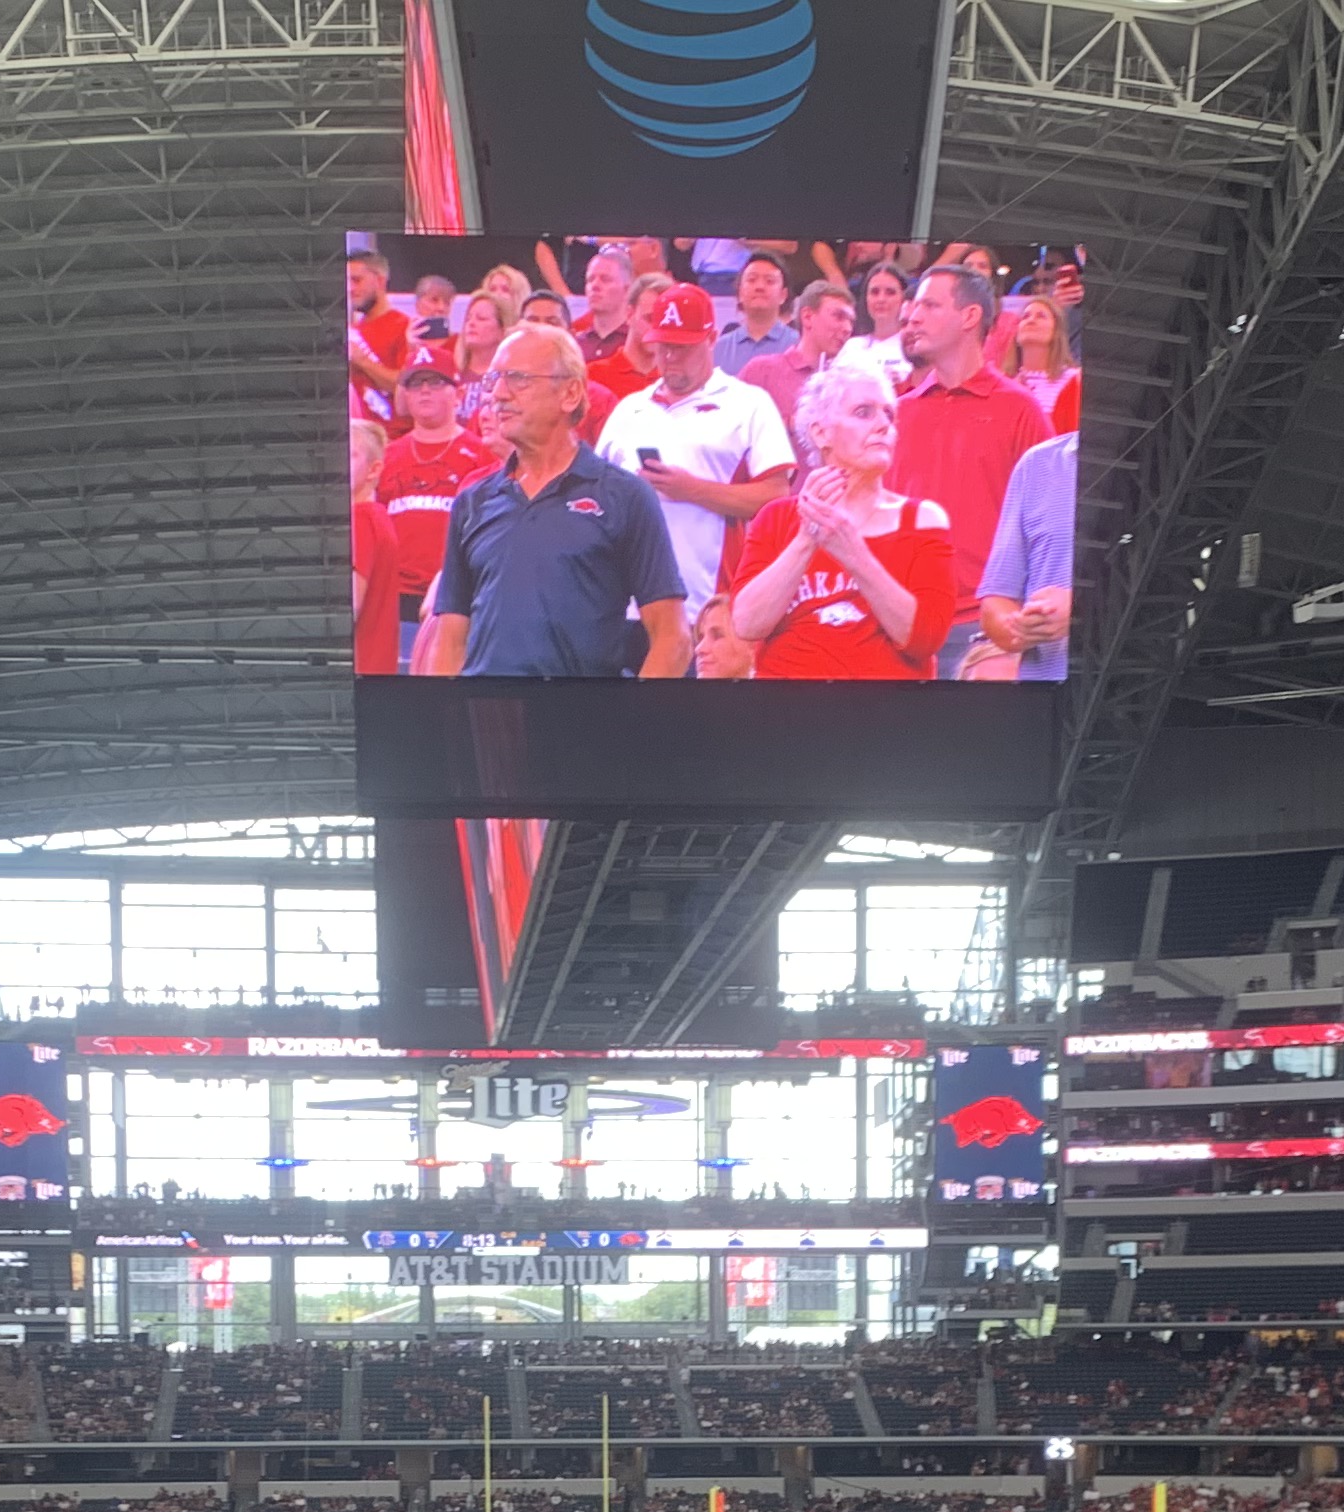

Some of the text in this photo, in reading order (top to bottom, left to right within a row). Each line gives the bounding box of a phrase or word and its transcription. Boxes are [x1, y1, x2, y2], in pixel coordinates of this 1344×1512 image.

[659, 301, 684, 327] A
[413, 346, 434, 365] A
[1065, 1031, 1210, 1054] RAZORBACKS
[32, 1045, 61, 1063] Lite
[941, 1049, 969, 1067] Lite
[1011, 1047, 1041, 1066] Lite
[468, 1075, 571, 1129] Lite
[1064, 1143, 1212, 1163] RAZORBACKS
[34, 1181, 64, 1200] Lite
[942, 1181, 971, 1200] Lite
[1011, 1181, 1040, 1199] Lite
[223, 1234, 249, 1246] Your
[251, 1235, 283, 1246] team.
[283, 1234, 309, 1246] Your
[409, 1233, 421, 1247] 0
[462, 1233, 496, 1247] 8:13
[598, 1233, 610, 1247] 0
[389, 1255, 630, 1286] AT&T STADIUM
